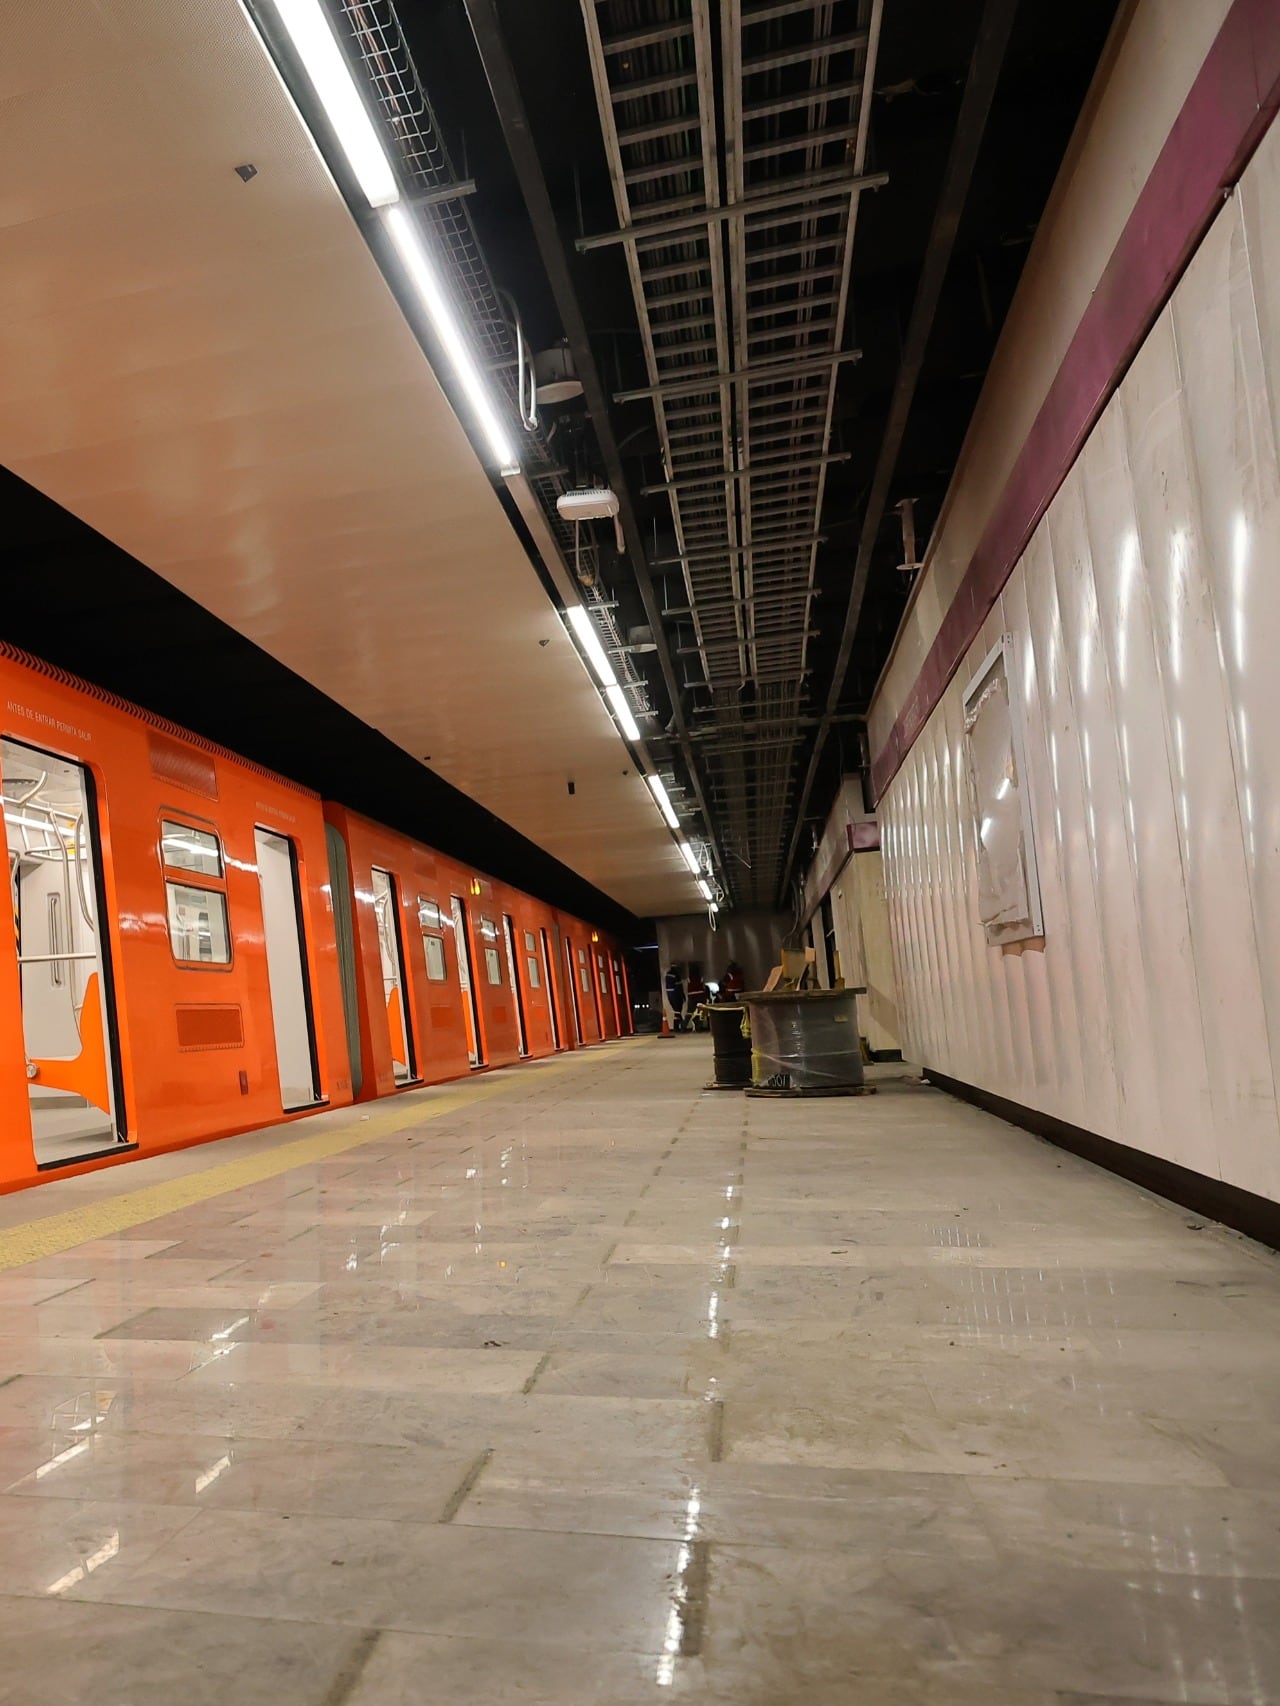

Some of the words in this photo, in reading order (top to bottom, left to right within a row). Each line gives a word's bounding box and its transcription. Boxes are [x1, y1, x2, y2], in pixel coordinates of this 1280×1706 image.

[7, 701, 25, 716] ANTES
[26, 709, 35, 720] DE
[35, 712, 56, 728] ENTRAR
